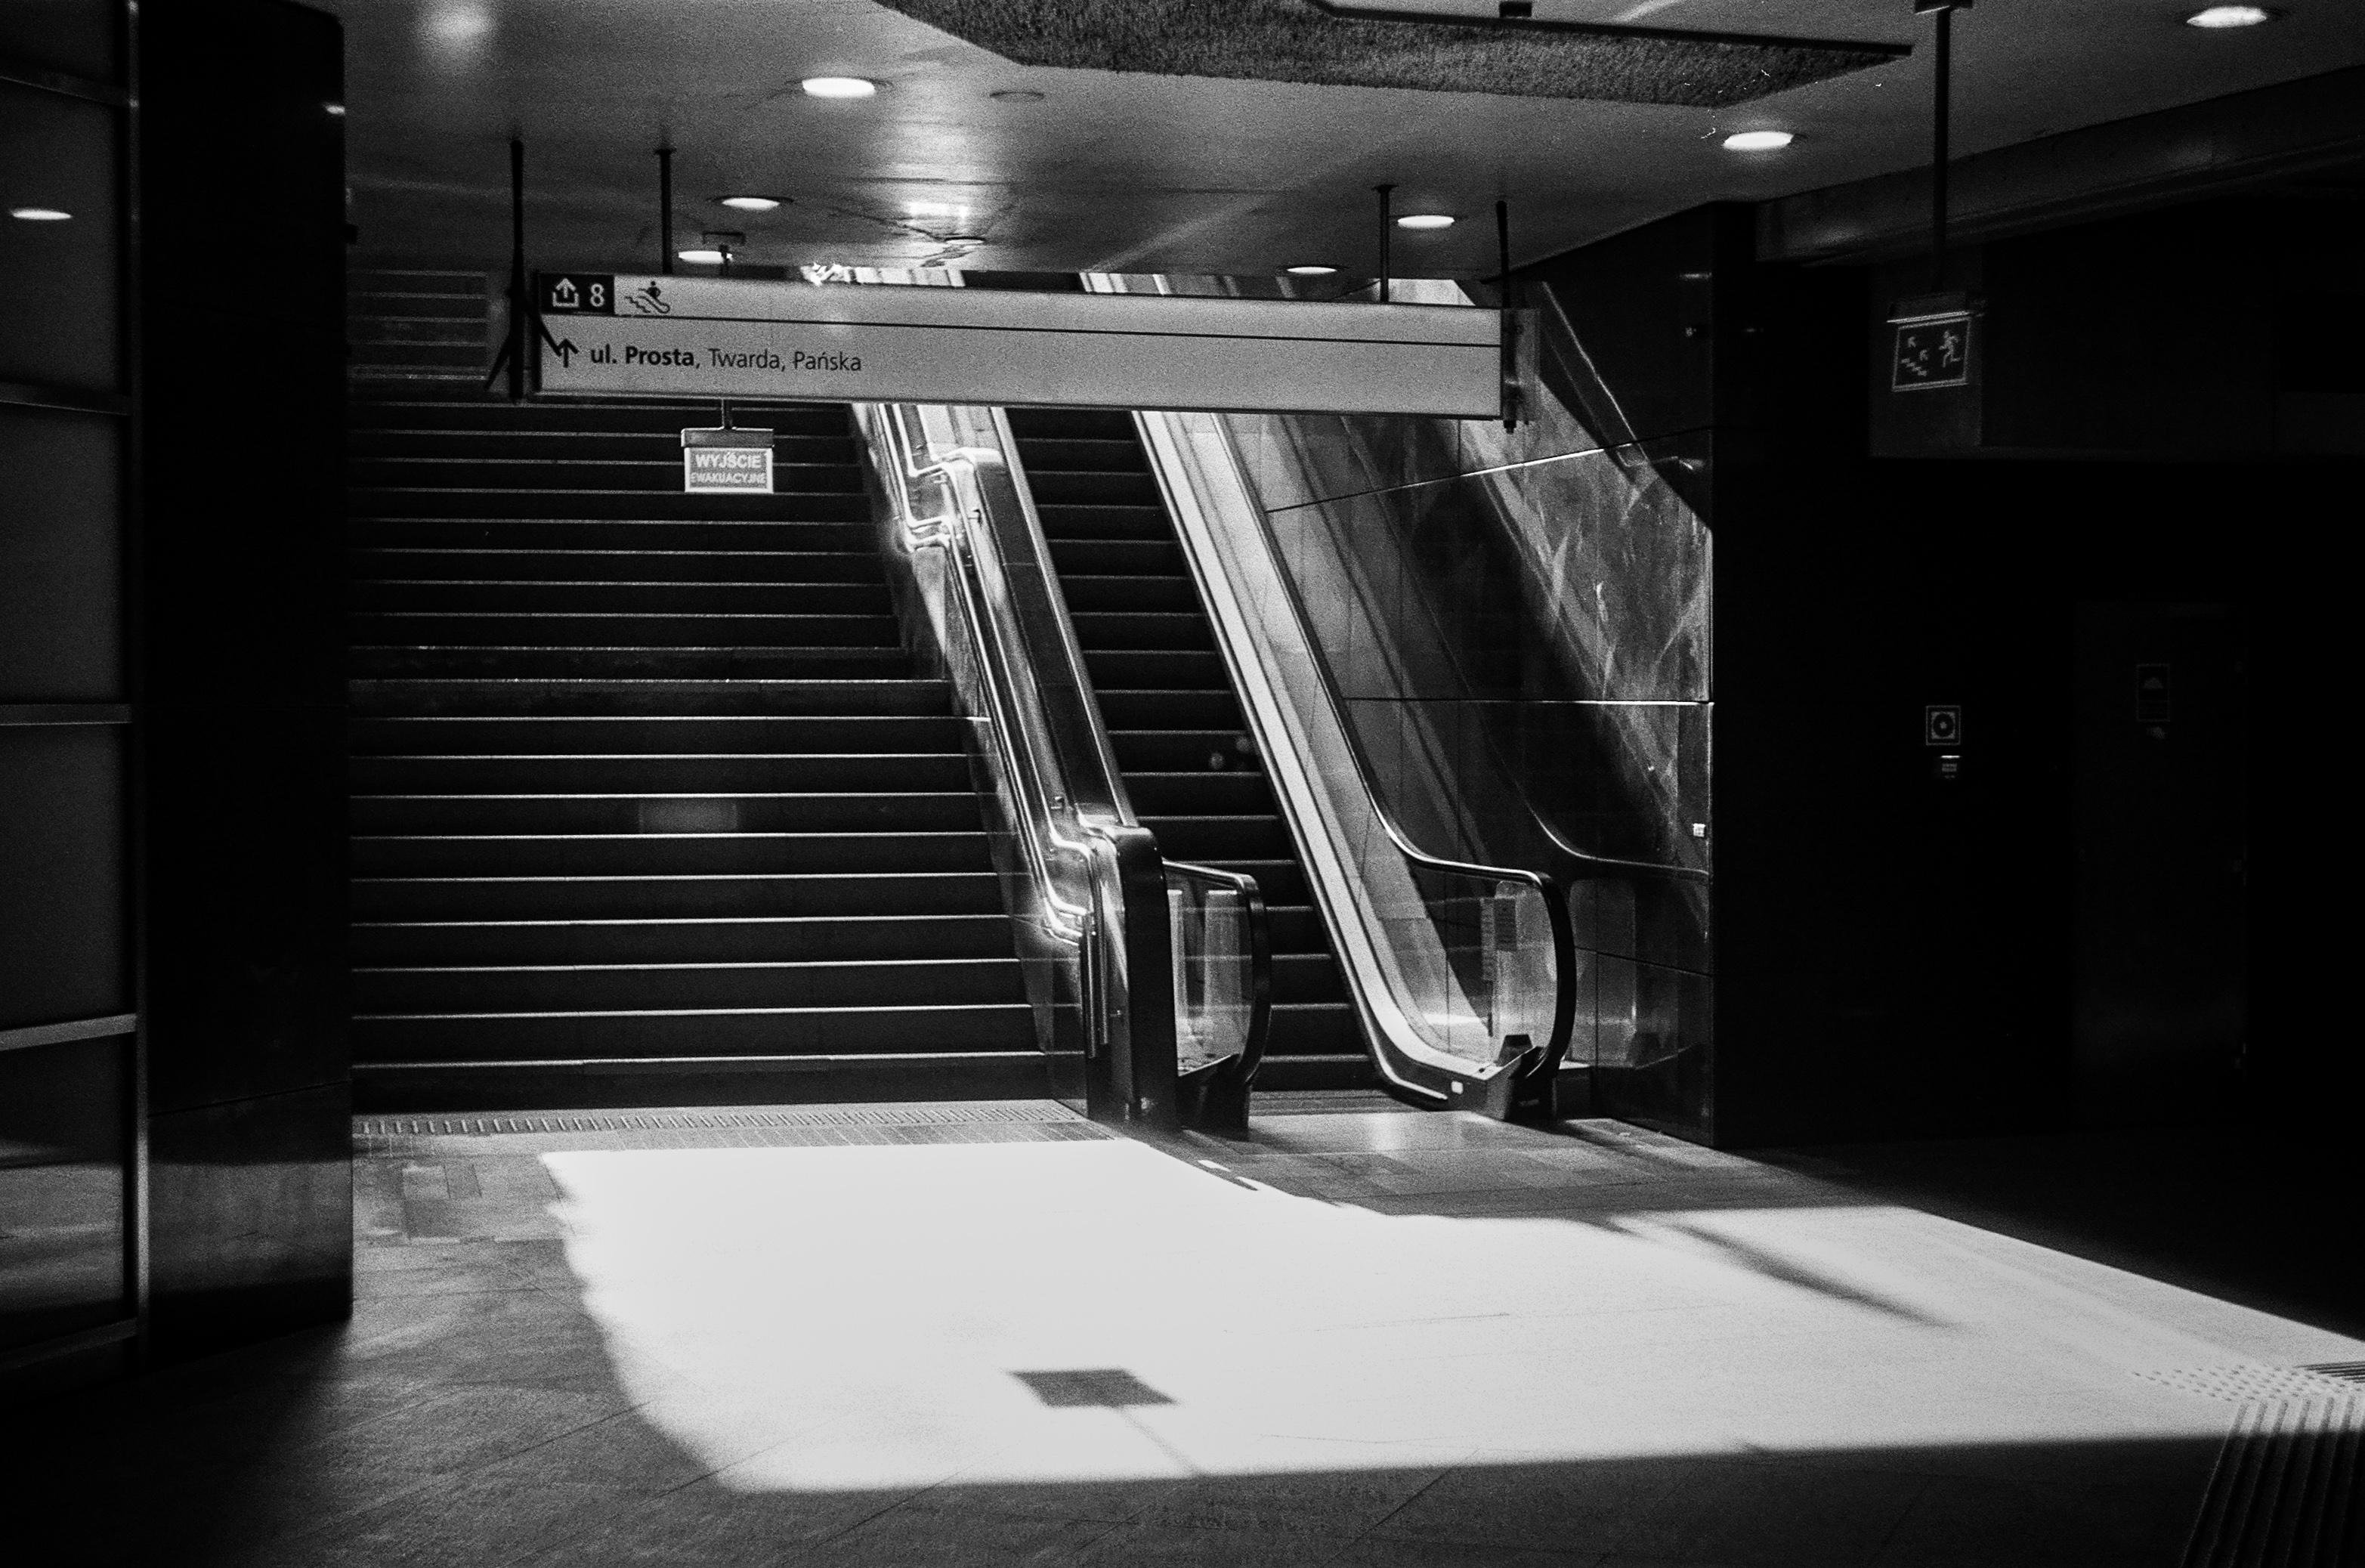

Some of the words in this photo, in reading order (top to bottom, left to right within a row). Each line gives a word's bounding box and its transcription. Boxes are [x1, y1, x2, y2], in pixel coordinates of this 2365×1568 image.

[590, 283, 604, 308] 8
[590, 346, 617, 365] ul.
[625, 346, 700, 370] Prosta,
[708, 348, 786, 372] Twarda,
[793, 350, 862, 371] Pańska
[695, 452, 762, 469] WYJŚCIE
[691, 472, 766, 484] EWAKUACYJNE
